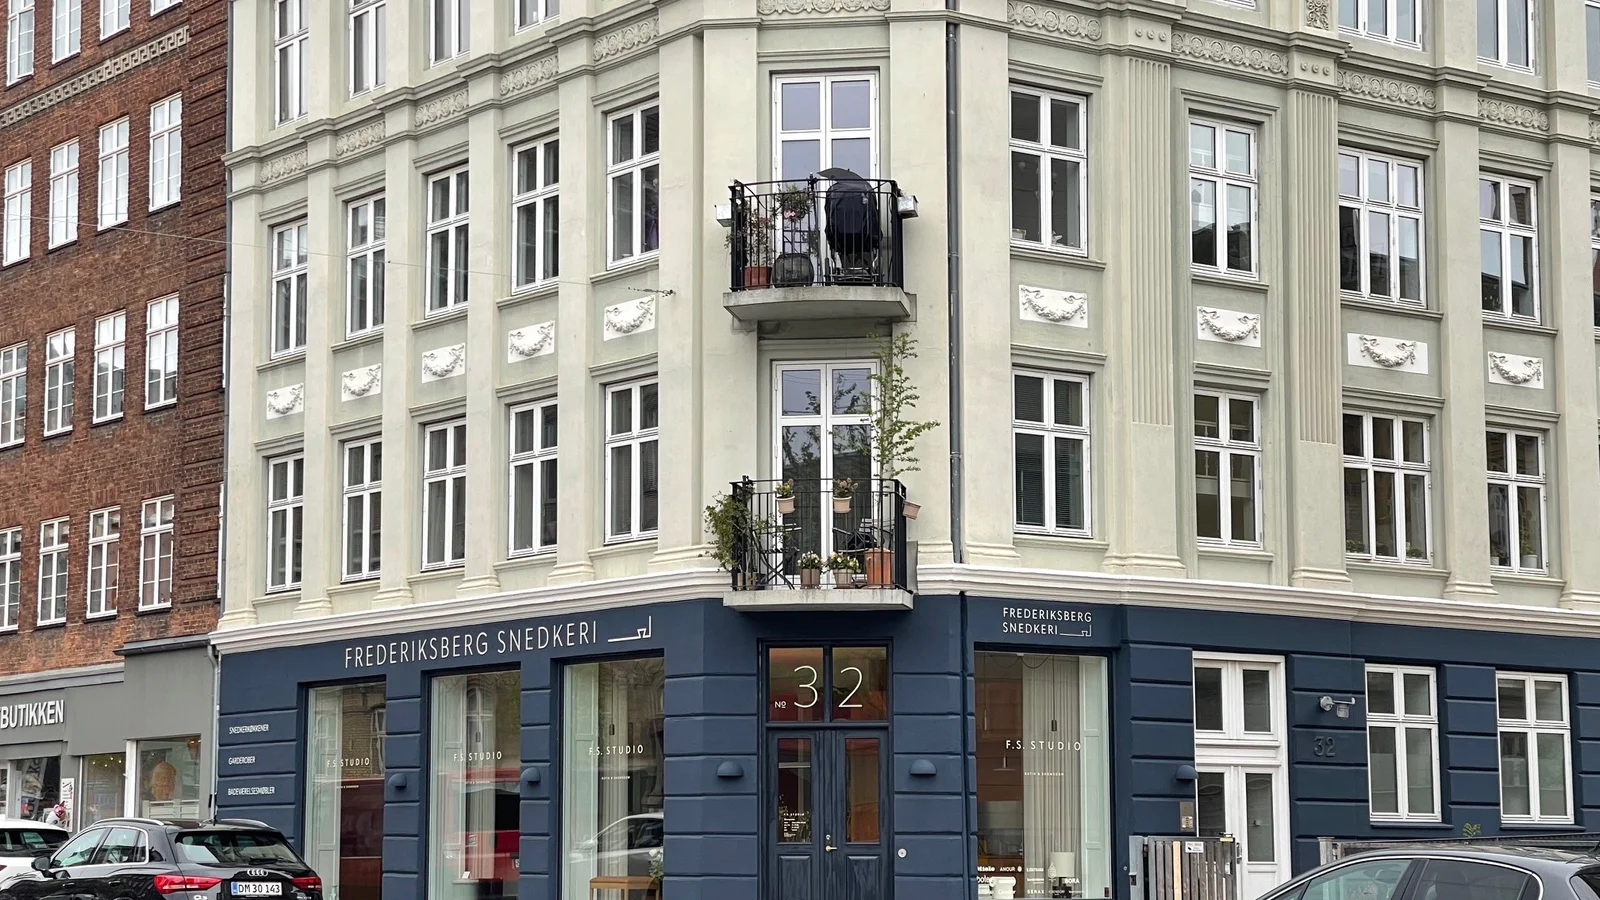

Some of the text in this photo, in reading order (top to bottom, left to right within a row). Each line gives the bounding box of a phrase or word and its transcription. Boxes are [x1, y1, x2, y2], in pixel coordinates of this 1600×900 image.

[1003, 607, 1092, 623] FREDERIKSBERG
[1002, 621, 1058, 635] SNEDKERI
[345, 620, 596, 669] FREDERIKSBERG SNEDKERI
[0, 699, 64, 729] BUTIKKEN
[589, 744, 644, 756] F.S. STUDIO
[1006, 739, 1081, 751] F.S. STUDIO
[1314, 736, 1337, 758] 32
[340, 757, 370, 767] STUDIO
[468, 750, 502, 761] STUDIO
[238, 884, 281, 893] DM 30 143
